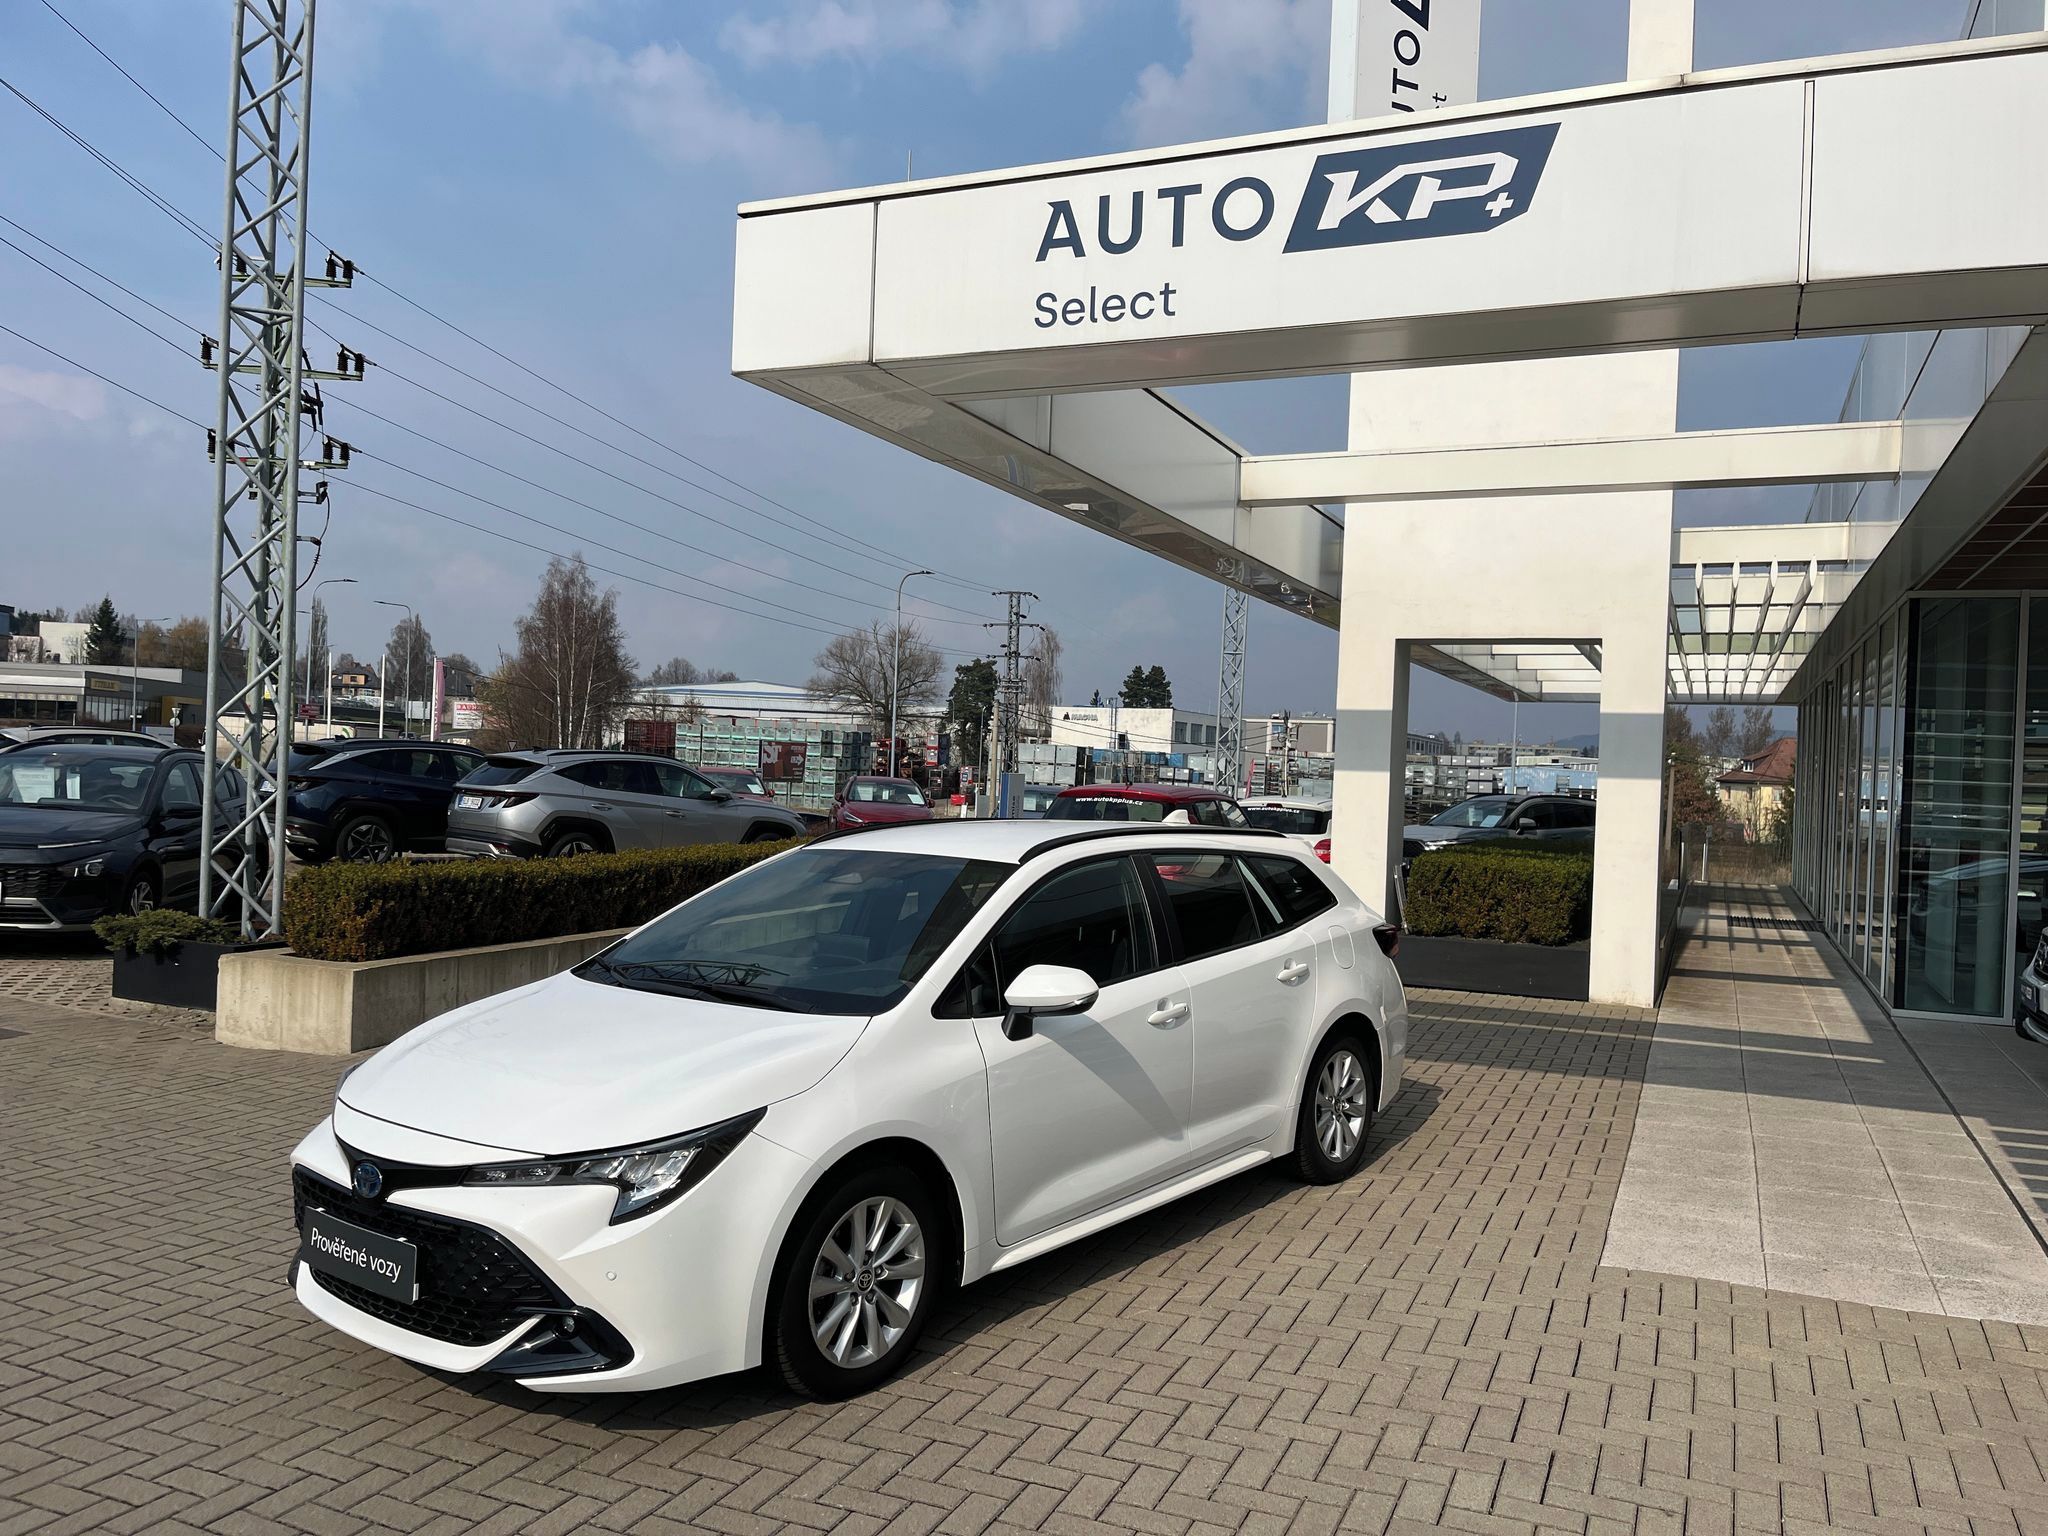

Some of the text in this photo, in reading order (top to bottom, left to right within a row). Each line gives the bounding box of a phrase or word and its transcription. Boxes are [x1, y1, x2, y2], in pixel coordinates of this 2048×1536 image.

[1035, 176, 1275, 262] AUTO
[1034, 282, 1178, 328] Select
[1075, 796, 1144, 806] www.autokpplus.cz
[310, 1227, 402, 1283] Prověřené vozy
